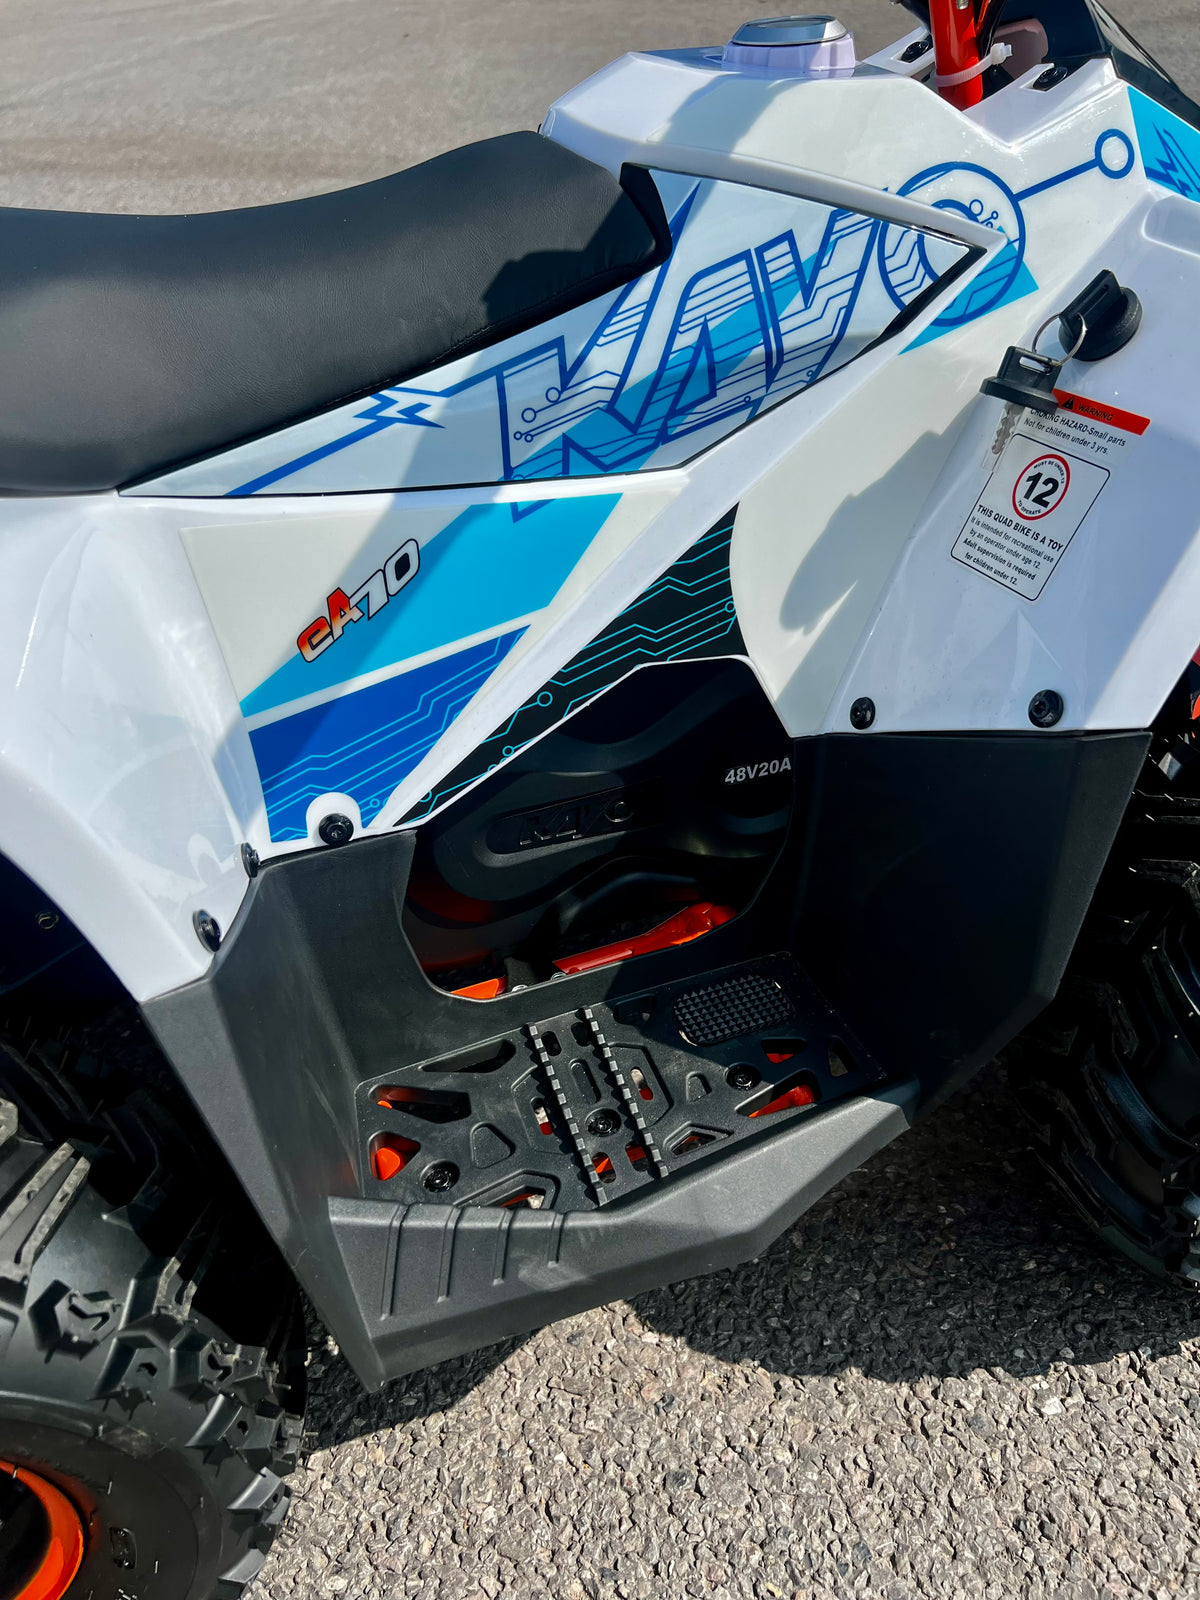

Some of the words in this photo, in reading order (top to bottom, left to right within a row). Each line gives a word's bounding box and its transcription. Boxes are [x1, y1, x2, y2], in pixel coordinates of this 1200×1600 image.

[1078, 403, 1114, 421] WARNING
[1024, 418, 1035, 428] Not
[1035, 421, 1045, 431] for
[1045, 425, 1070, 440] children
[1070, 436, 1090, 448] under
[1091, 441, 1096, 450] 3
[1095, 446, 1108, 455] yrs.
[1059, 417, 1108, 440] HAZARD-Small
[1107, 435, 1126, 447] parts
[1033, 460, 1048, 469] MUST
[1054, 463, 1065, 478] UNDER
[1023, 471, 1060, 508] 12
[1017, 500, 1023, 508] TO
[1021, 506, 1042, 515] OPERATE
[975, 518, 981, 526] is
[981, 520, 1003, 537] intended
[1003, 532, 1011, 541] for
[1011, 537, 1043, 557] recreational
[1043, 553, 1054, 563] use
[976, 504, 994, 518] THIS
[993, 513, 1013, 528] QUAD
[1013, 522, 1032, 537] BIKE
[1031, 531, 1040, 541] IS
[1040, 536, 1047, 544] A
[1047, 539, 1064, 552] TOY
[963, 538, 978, 550] Adult
[977, 545, 1006, 565] supervision
[1006, 560, 1012, 568] is
[1012, 563, 1037, 580] required
[970, 528, 977, 537] by
[977, 531, 984, 539] an
[984, 534, 1006, 550] operator
[1005, 546, 1022, 559] under
[1021, 555, 1032, 566] age
[965, 552, 973, 560] for
[972, 556, 994, 572] children
[993, 567, 1009, 580] under
[1009, 576, 1018, 586] 12.
[725, 757, 791, 783] 48V20A
